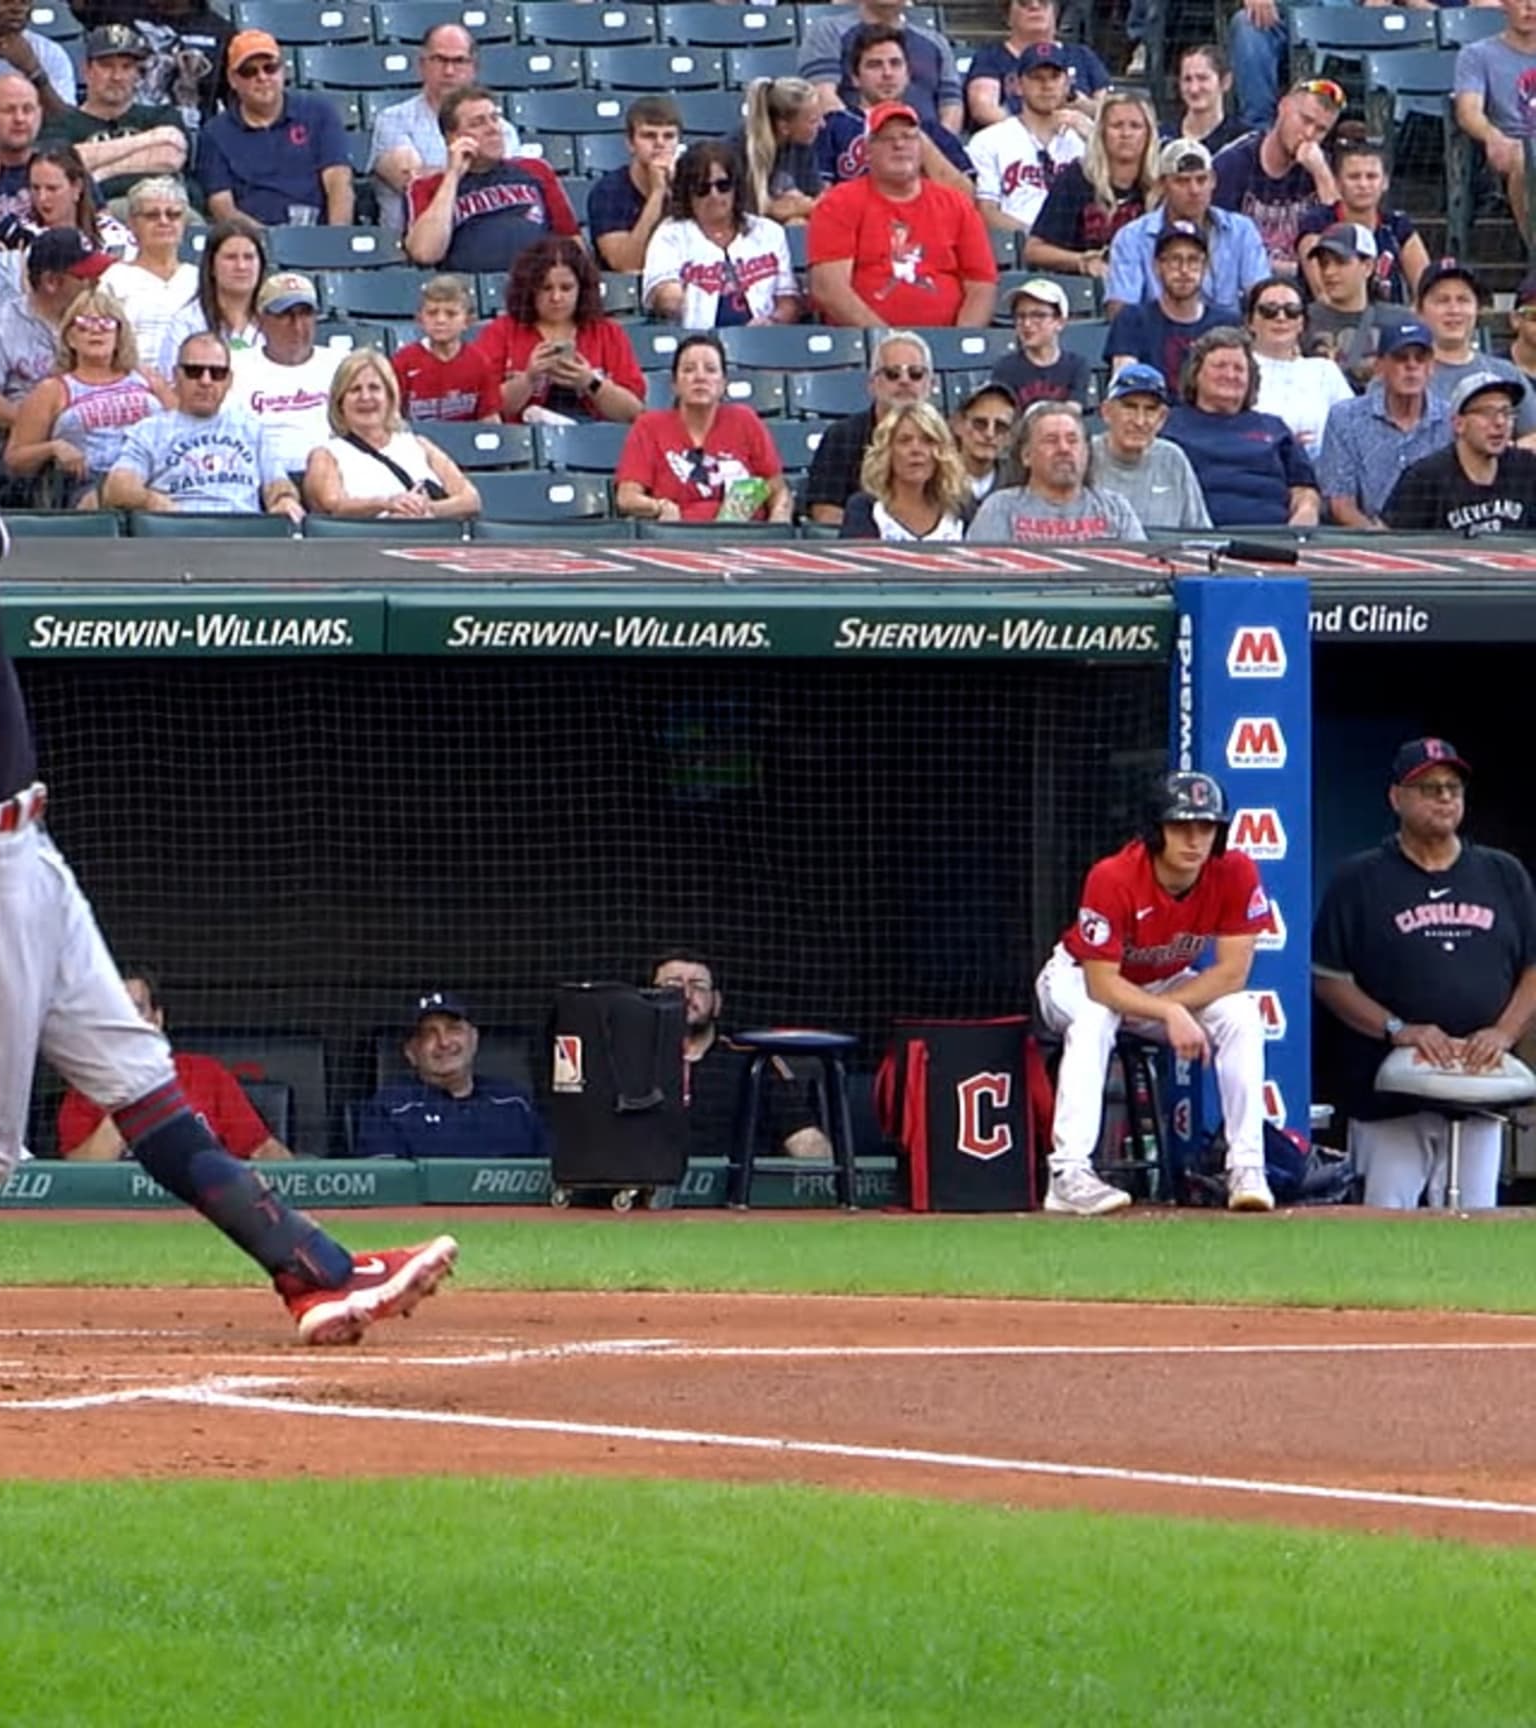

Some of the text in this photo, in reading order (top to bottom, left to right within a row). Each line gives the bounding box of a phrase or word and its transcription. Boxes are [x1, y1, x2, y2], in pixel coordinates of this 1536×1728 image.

[165, 434, 253, 467] CLEVELAND
[169, 471, 253, 494] BASEBALL
[1447, 499, 1523, 529] CLEVELAND
[1308, 604, 1429, 632] nd Clinic
[1395, 903, 1494, 933] CLEVELAND
[957, 1071, 1013, 1160] C
